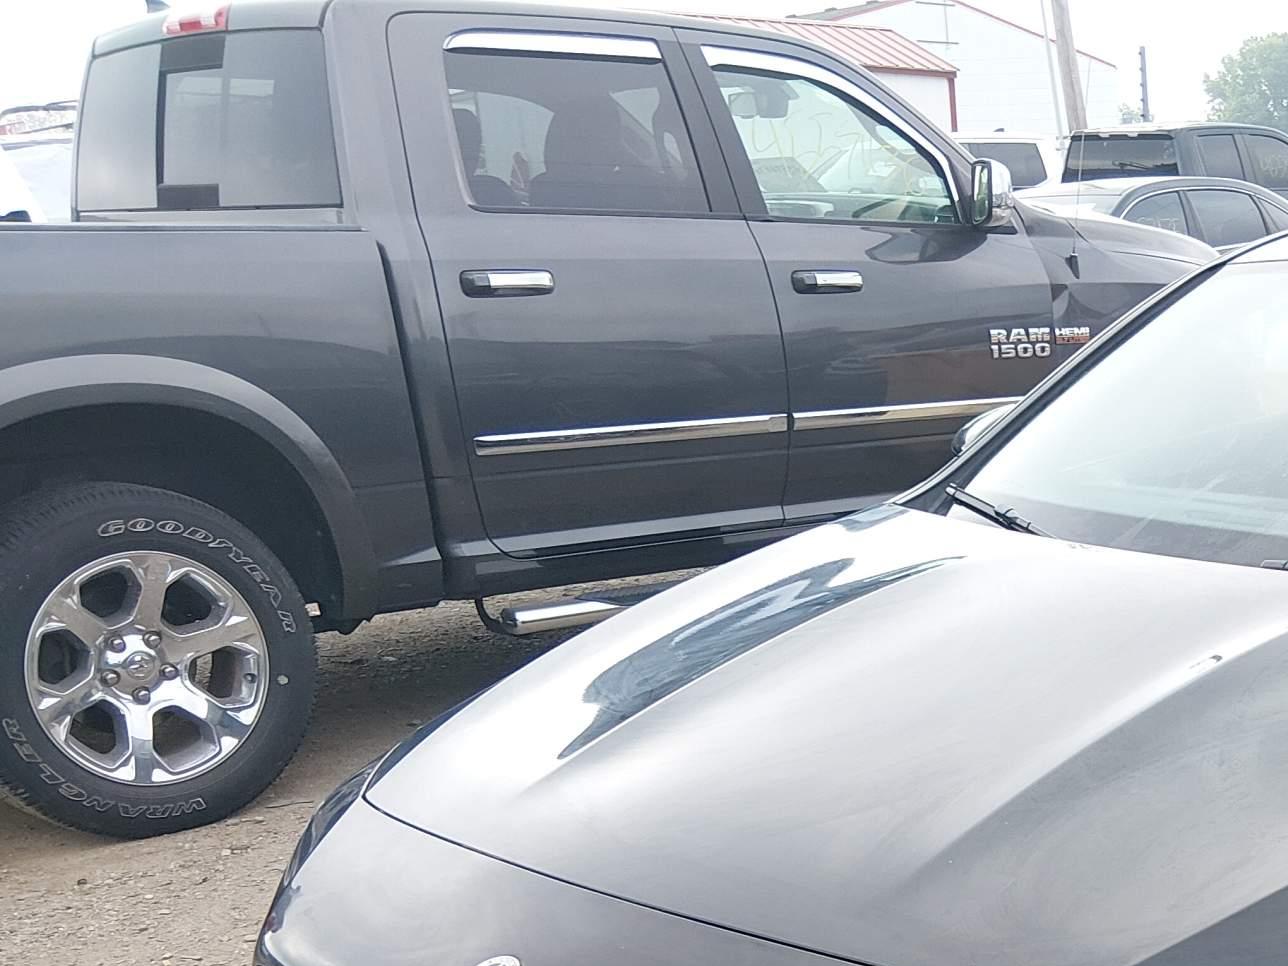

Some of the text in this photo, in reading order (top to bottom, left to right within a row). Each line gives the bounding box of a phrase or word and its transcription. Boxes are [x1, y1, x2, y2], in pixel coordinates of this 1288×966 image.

[989, 327, 1051, 343] RAM
[1054, 326, 1090, 337] HEMI
[990, 342, 1051, 359] 1500
[97, 518, 297, 634] GOODYEAR
[2, 718, 207, 819] WRANGLER
